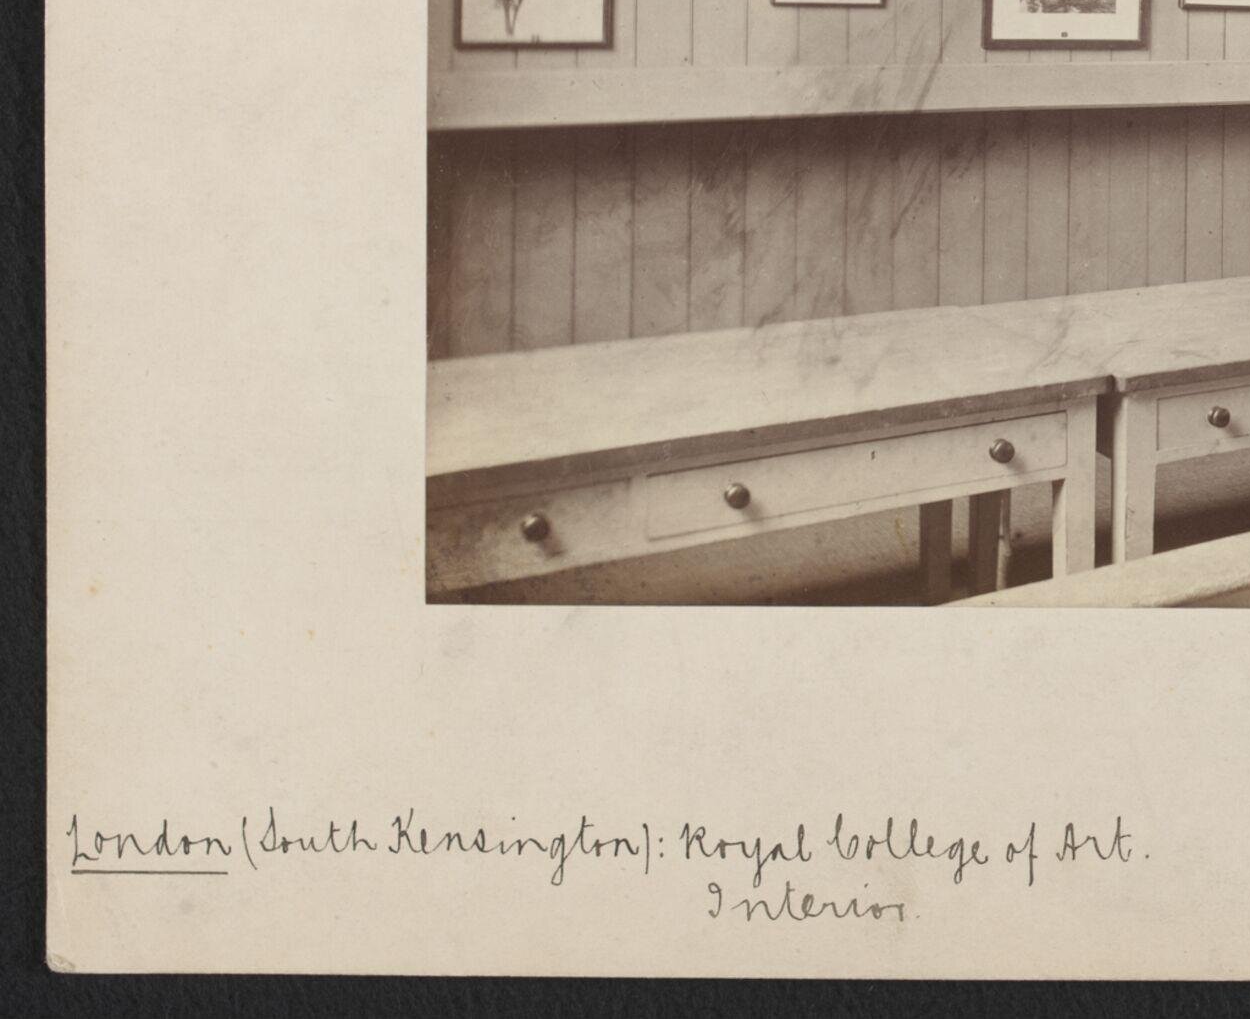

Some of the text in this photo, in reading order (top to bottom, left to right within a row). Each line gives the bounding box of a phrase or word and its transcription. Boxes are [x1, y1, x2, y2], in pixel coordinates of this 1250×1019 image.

[66, 806, 1149, 886] London (South Kensington): Royal College of Art.
[708, 881, 920, 922] Interior.
